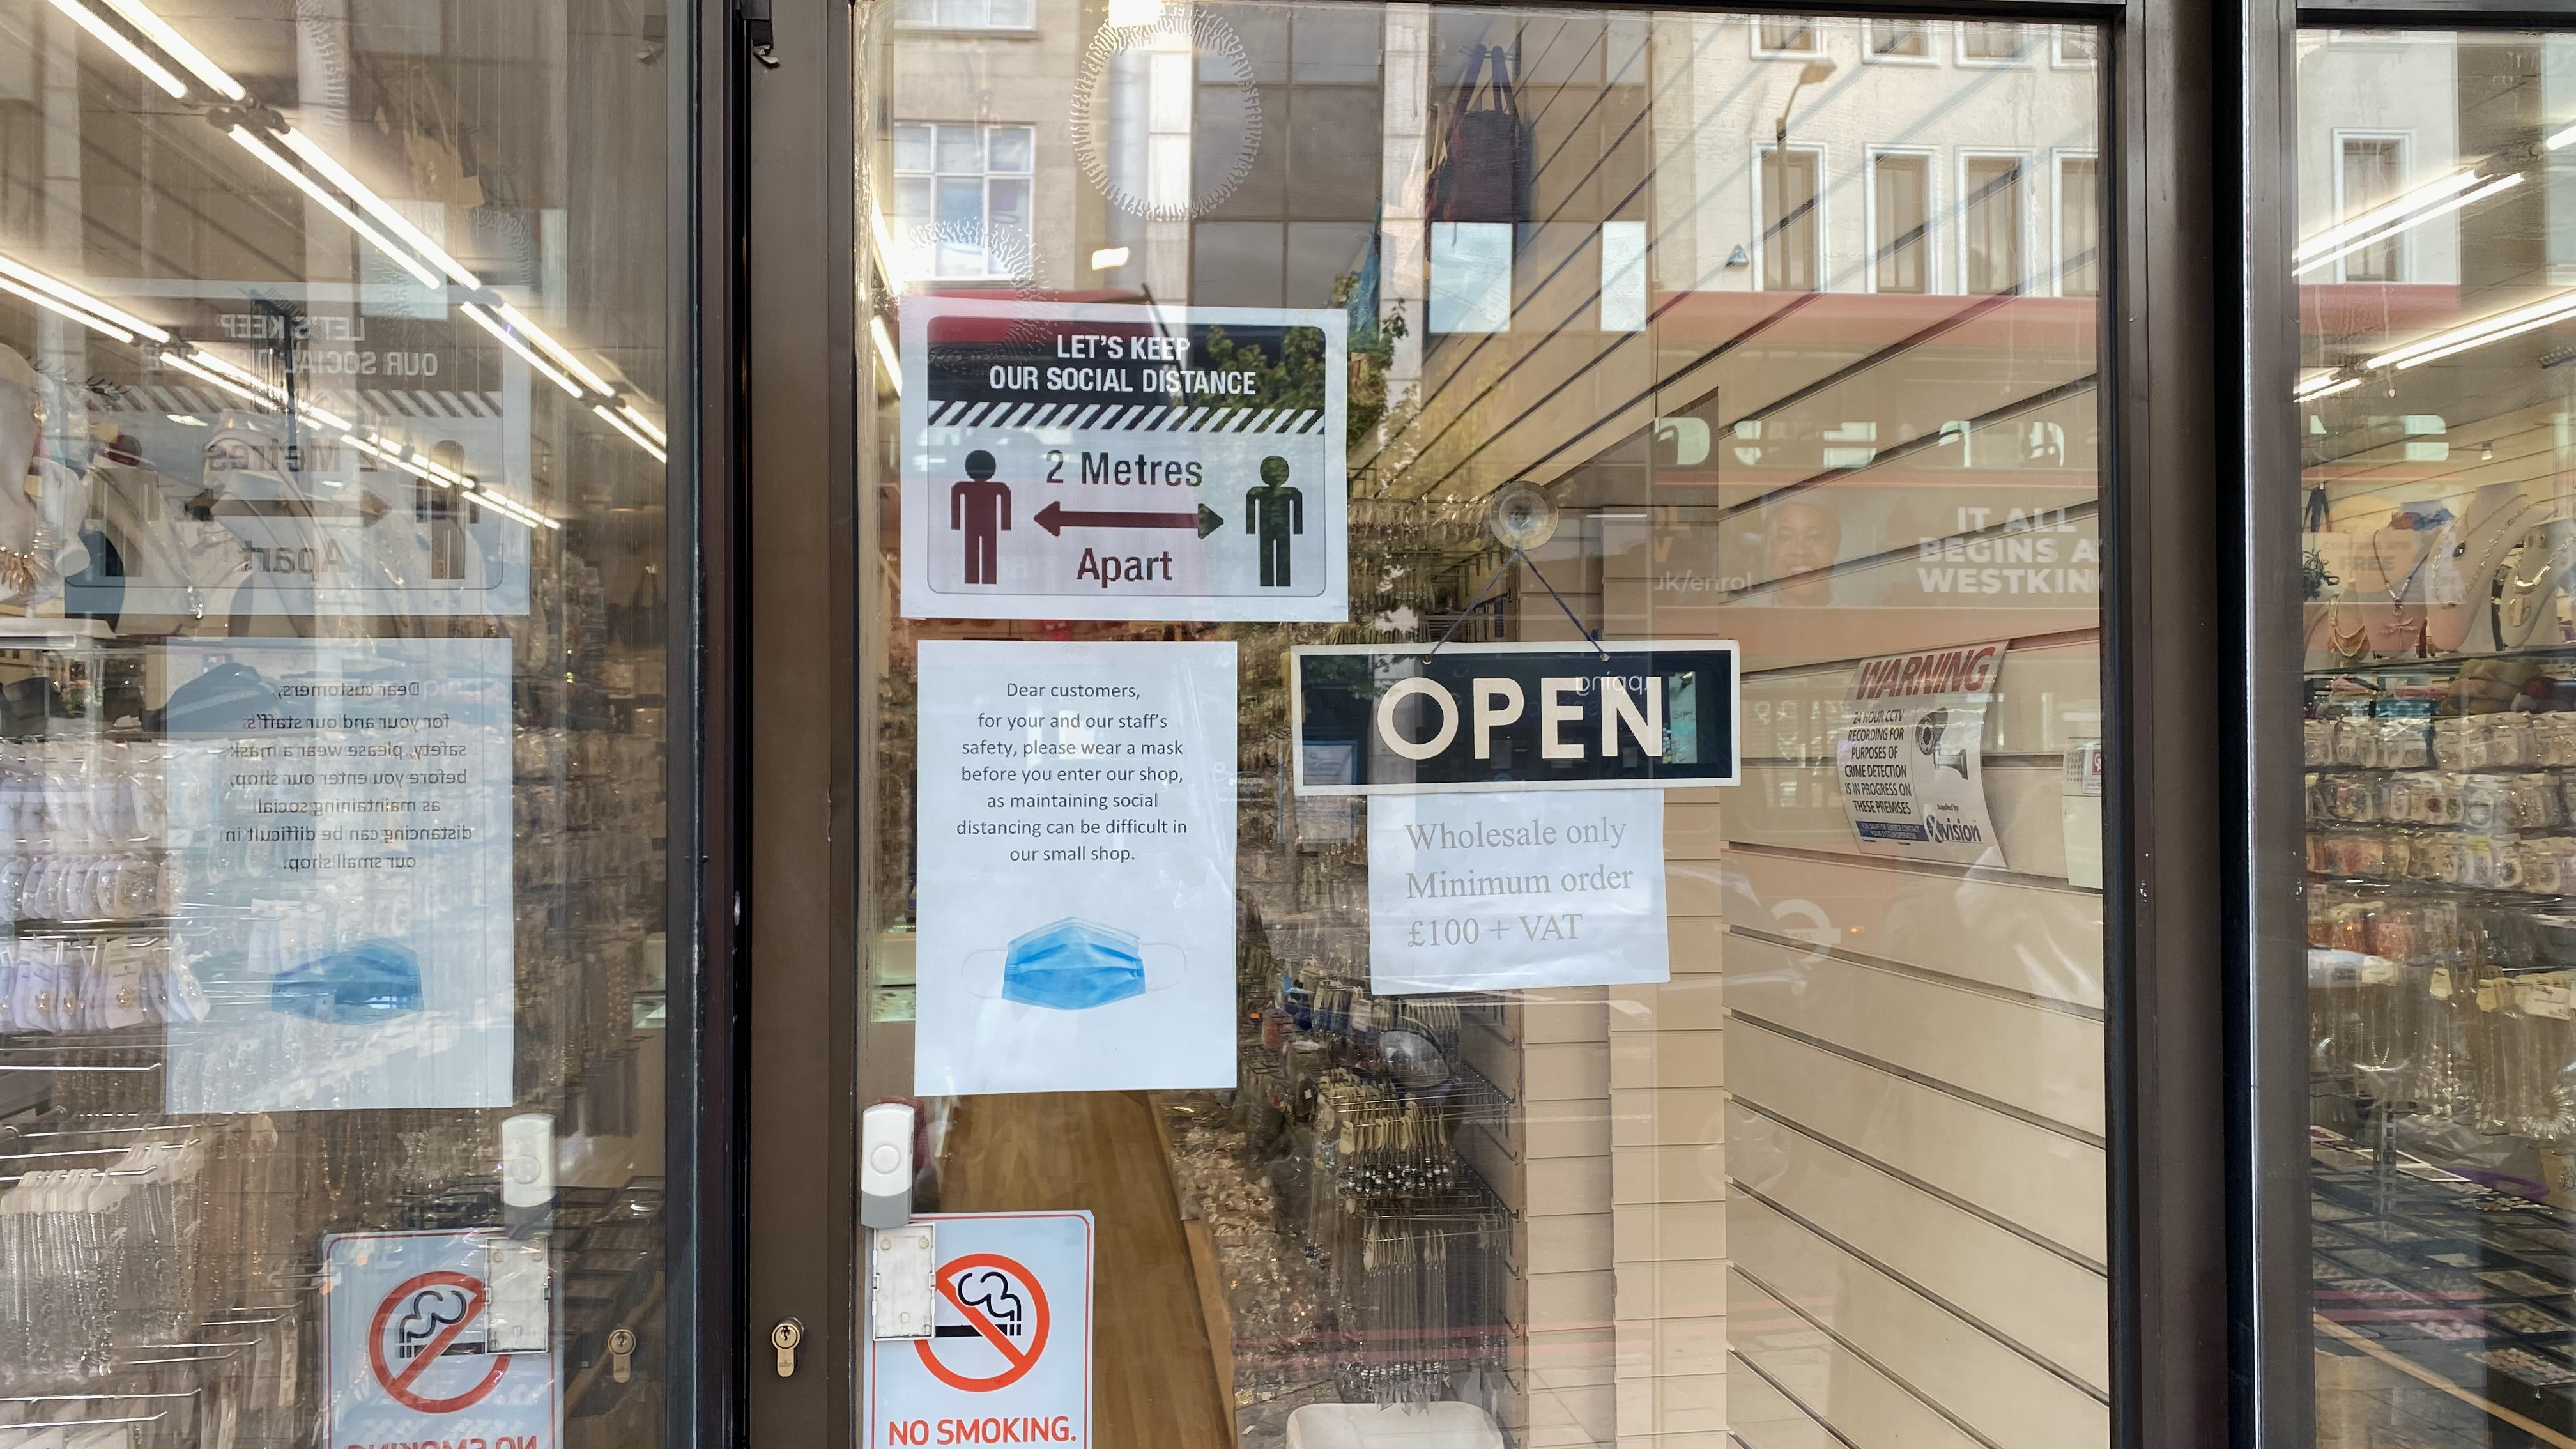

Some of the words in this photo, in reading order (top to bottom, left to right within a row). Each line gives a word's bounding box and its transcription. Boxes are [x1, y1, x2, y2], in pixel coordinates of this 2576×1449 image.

[1057, 335, 1124, 358] LET'S
[1131, 337, 1190, 360] KEEP
[990, 366, 1038, 390] OUR
[1047, 368, 1133, 392] SOCIAL
[1143, 369, 1256, 395] DISTANCE
[1046, 450, 1064, 484] 2
[1082, 452, 1202, 487] Metres
[1958, 507, 1991, 532] IT
[2002, 507, 2076, 533] ALL
[1919, 537, 2058, 564] BEGINS
[1077, 548, 1172, 588] Apart
[1917, 567, 2099, 594] WESTKIN
[1856, 647, 1996, 700] WARNING
[1007, 683, 1045, 697] Dear
[1050, 685, 1140, 700] customers,
[978, 713, 1002, 728] for
[1008, 717, 1045, 731] your
[1050, 714, 1080, 728] and
[1085, 716, 1114, 728] our
[1118, 714, 1168, 728] staff's
[1377, 676, 1662, 760] OPEN
[1853, 712, 1862, 724] 24
[1863, 710, 1884, 723] HOUR
[1885, 709, 1905, 722] CCTV
[1848, 728, 1888, 742] RECORDING
[1890, 728, 1904, 740] FOR
[962, 740, 1017, 757] safety,
[1023, 740, 1076, 758] please
[1081, 742, 1122, 755] wear
[1127, 742, 1135, 755] a
[1141, 740, 1183, 755] mask
[1851, 747, 1886, 759] PURPOSES
[1889, 746, 1897, 758] OF
[962, 766, 1016, 781] before
[1022, 769, 1052, 784] you
[1057, 768, 1101, 781] enter
[1107, 769, 1135, 781] our
[1140, 767, 1183, 784] shop,
[1845, 765, 1866, 778] CRIME
[1867, 765, 1906, 778] DETECTION
[1845, 783, 1851, 794] IS
[1853, 783, 1860, 795] IN
[1861, 783, 1898, 795] PROGRESS
[1899, 783, 1912, 796] ON
[988, 796, 1004, 808] as
[1011, 793, 1107, 810] maintaining
[1113, 793, 1158, 808] social
[1853, 800, 1875, 813] THESE
[1875, 801, 1911, 814] PREMISES
[957, 820, 1041, 837] distancing
[1046, 823, 1074, 834] can
[1081, 820, 1100, 834] be
[1106, 819, 1168, 833] difficult
[1173, 819, 1187, 833] in
[1404, 818, 1556, 850] Wholesale
[1567, 816, 1627, 849] only
[1010, 849, 1038, 861] our
[1043, 846, 1085, 861] small
[1091, 846, 1135, 863] shop.
[1406, 869, 1552, 898] Minimum
[1561, 864, 1634, 892] order
[1408, 918, 1479, 947] £100
[1489, 920, 1509, 940] +
[1518, 914, 1583, 942] VAT
[889, 1420, 929, 1446] NO
[937, 1416, 1076, 1445] SMOKING.
